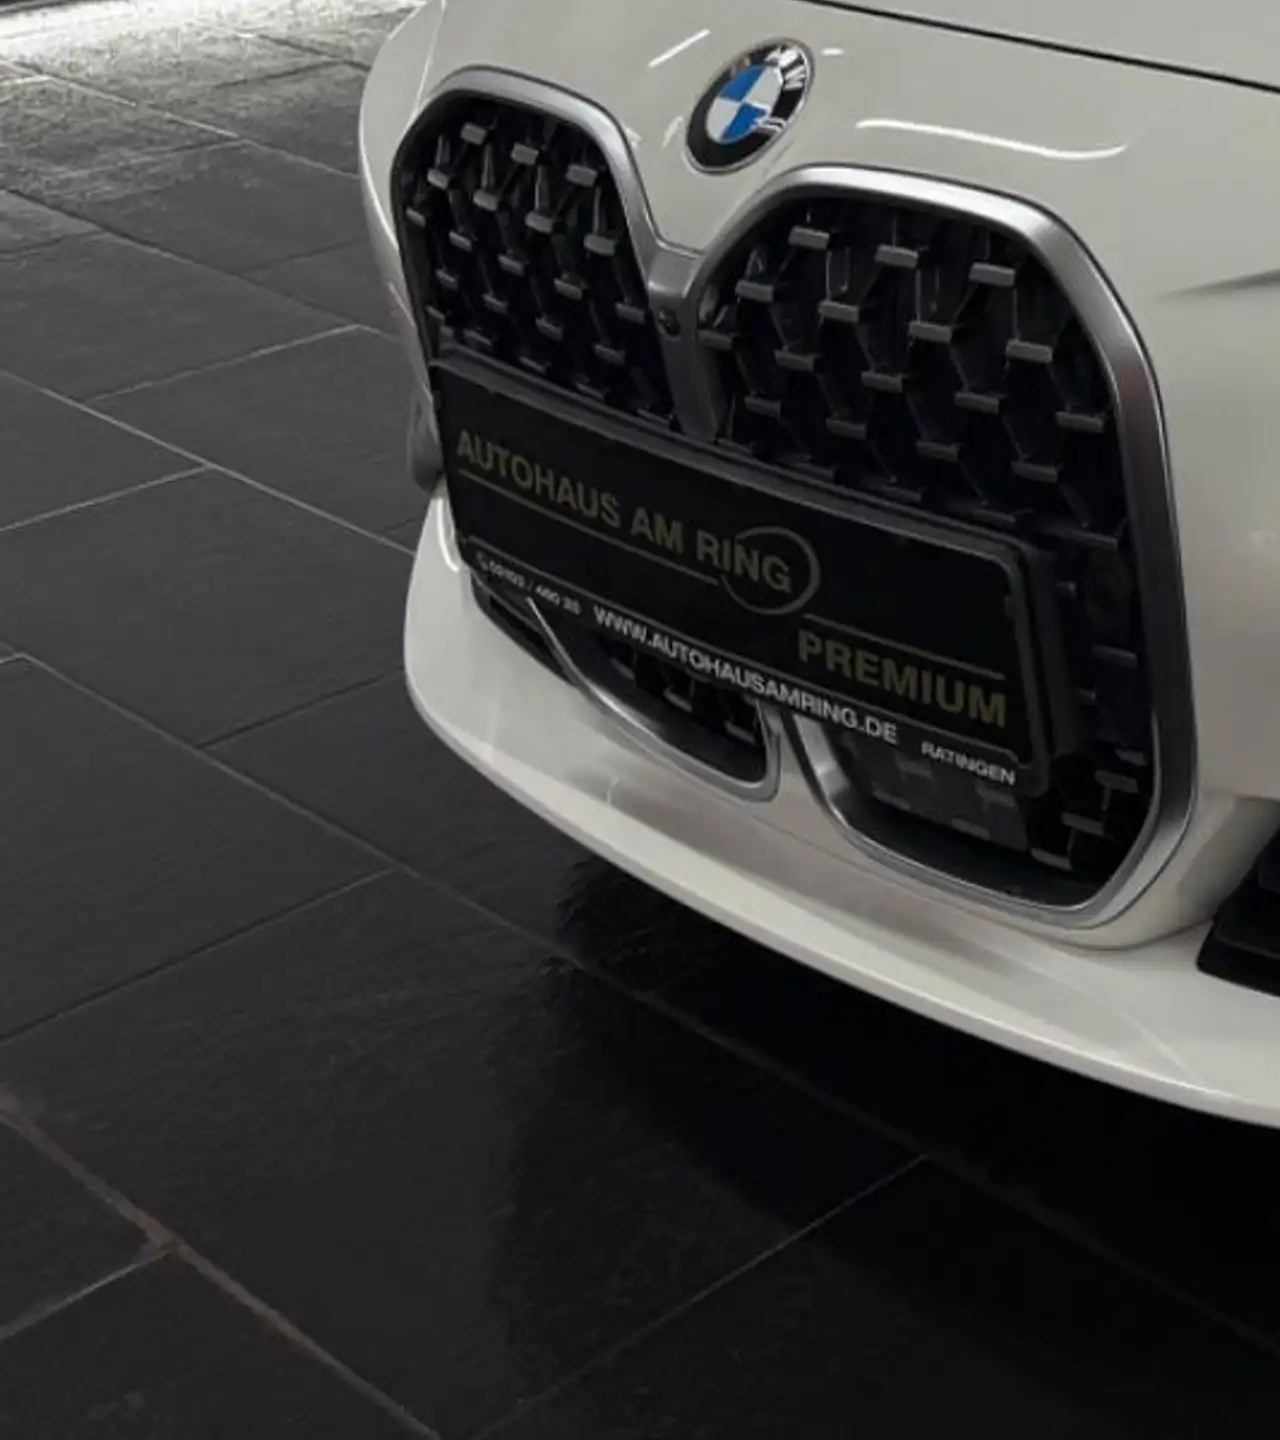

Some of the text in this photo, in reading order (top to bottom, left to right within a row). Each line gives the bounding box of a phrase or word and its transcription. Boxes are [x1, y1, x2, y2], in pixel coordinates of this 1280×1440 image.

[457, 428, 792, 594] AUTOHAUS AM RING
[593, 605, 898, 744] WWW.AUTOHAUSAMRING.DE
[799, 628, 1006, 728] PREMIUM
